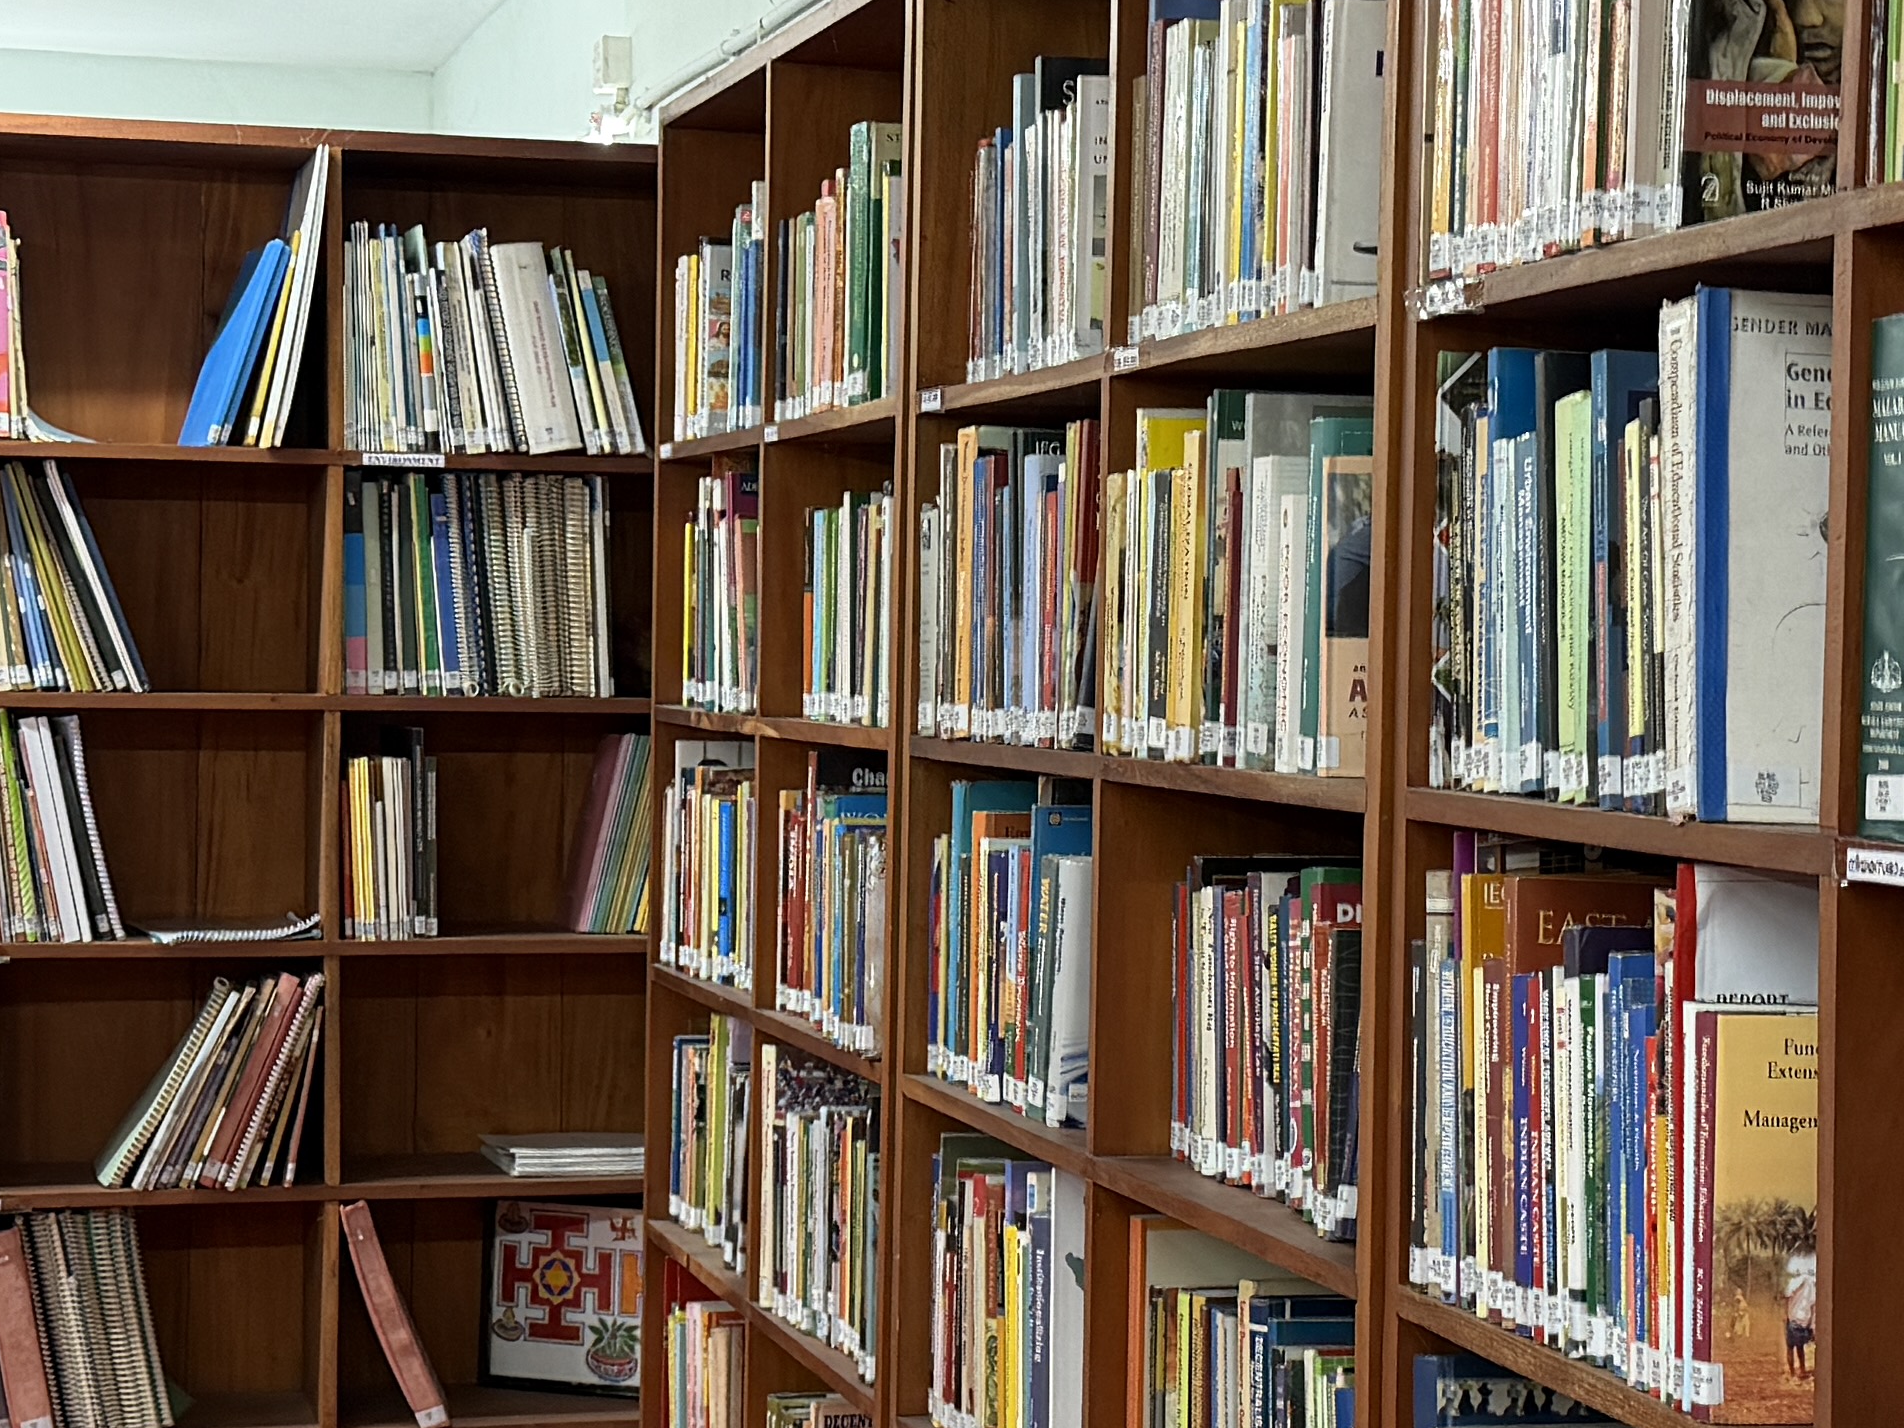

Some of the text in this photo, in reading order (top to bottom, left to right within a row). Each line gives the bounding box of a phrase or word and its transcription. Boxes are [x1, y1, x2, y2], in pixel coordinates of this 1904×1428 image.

[1762, 111, 1786, 128] and
[1704, 132, 1801, 145] Political Economy of
[1777, 180, 1816, 196] Kumar
[1787, 389, 1805, 408] in
[1785, 424, 1794, 435] A
[1785, 442, 1808, 456] and
[368, 455, 440, 465] ENVIRONMENT
[1039, 877, 1050, 934] WATER
[1227, 917, 1236, 1048] Right to Information
[1520, 1117, 1529, 1255] INDIAN CASTE
[1531, 1131, 1540, 1268] INDIAN CASTE
